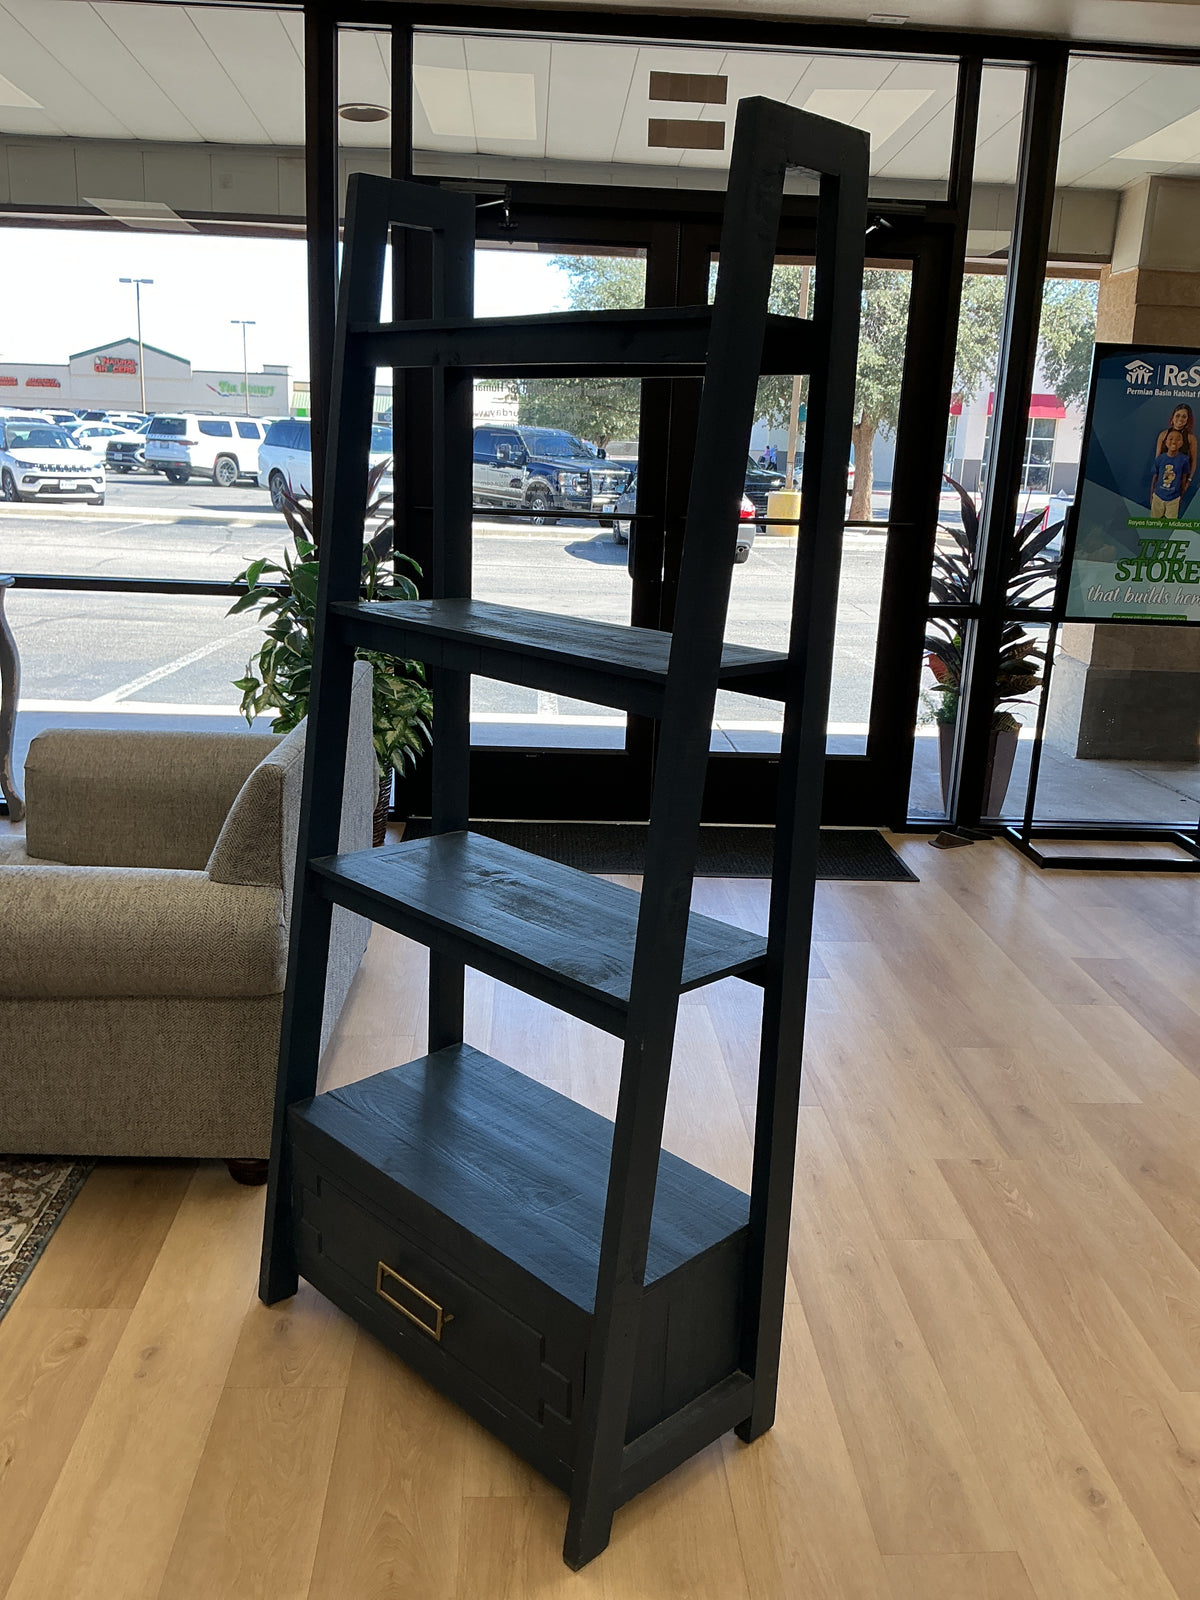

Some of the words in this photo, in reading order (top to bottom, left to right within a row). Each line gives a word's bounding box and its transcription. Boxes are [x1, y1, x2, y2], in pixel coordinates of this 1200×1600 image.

[1126, 387, 1153, 396] Permian
[1154, 388, 1172, 396] Basin
[1173, 390, 1196, 398] Habitat
[1146, 520, 1163, 528] family
[1138, 539, 1190, 561] THE
[1115, 558, 1200, 583] STORE
[1088, 585, 1120, 602] that
[1124, 586, 1171, 605] builds
